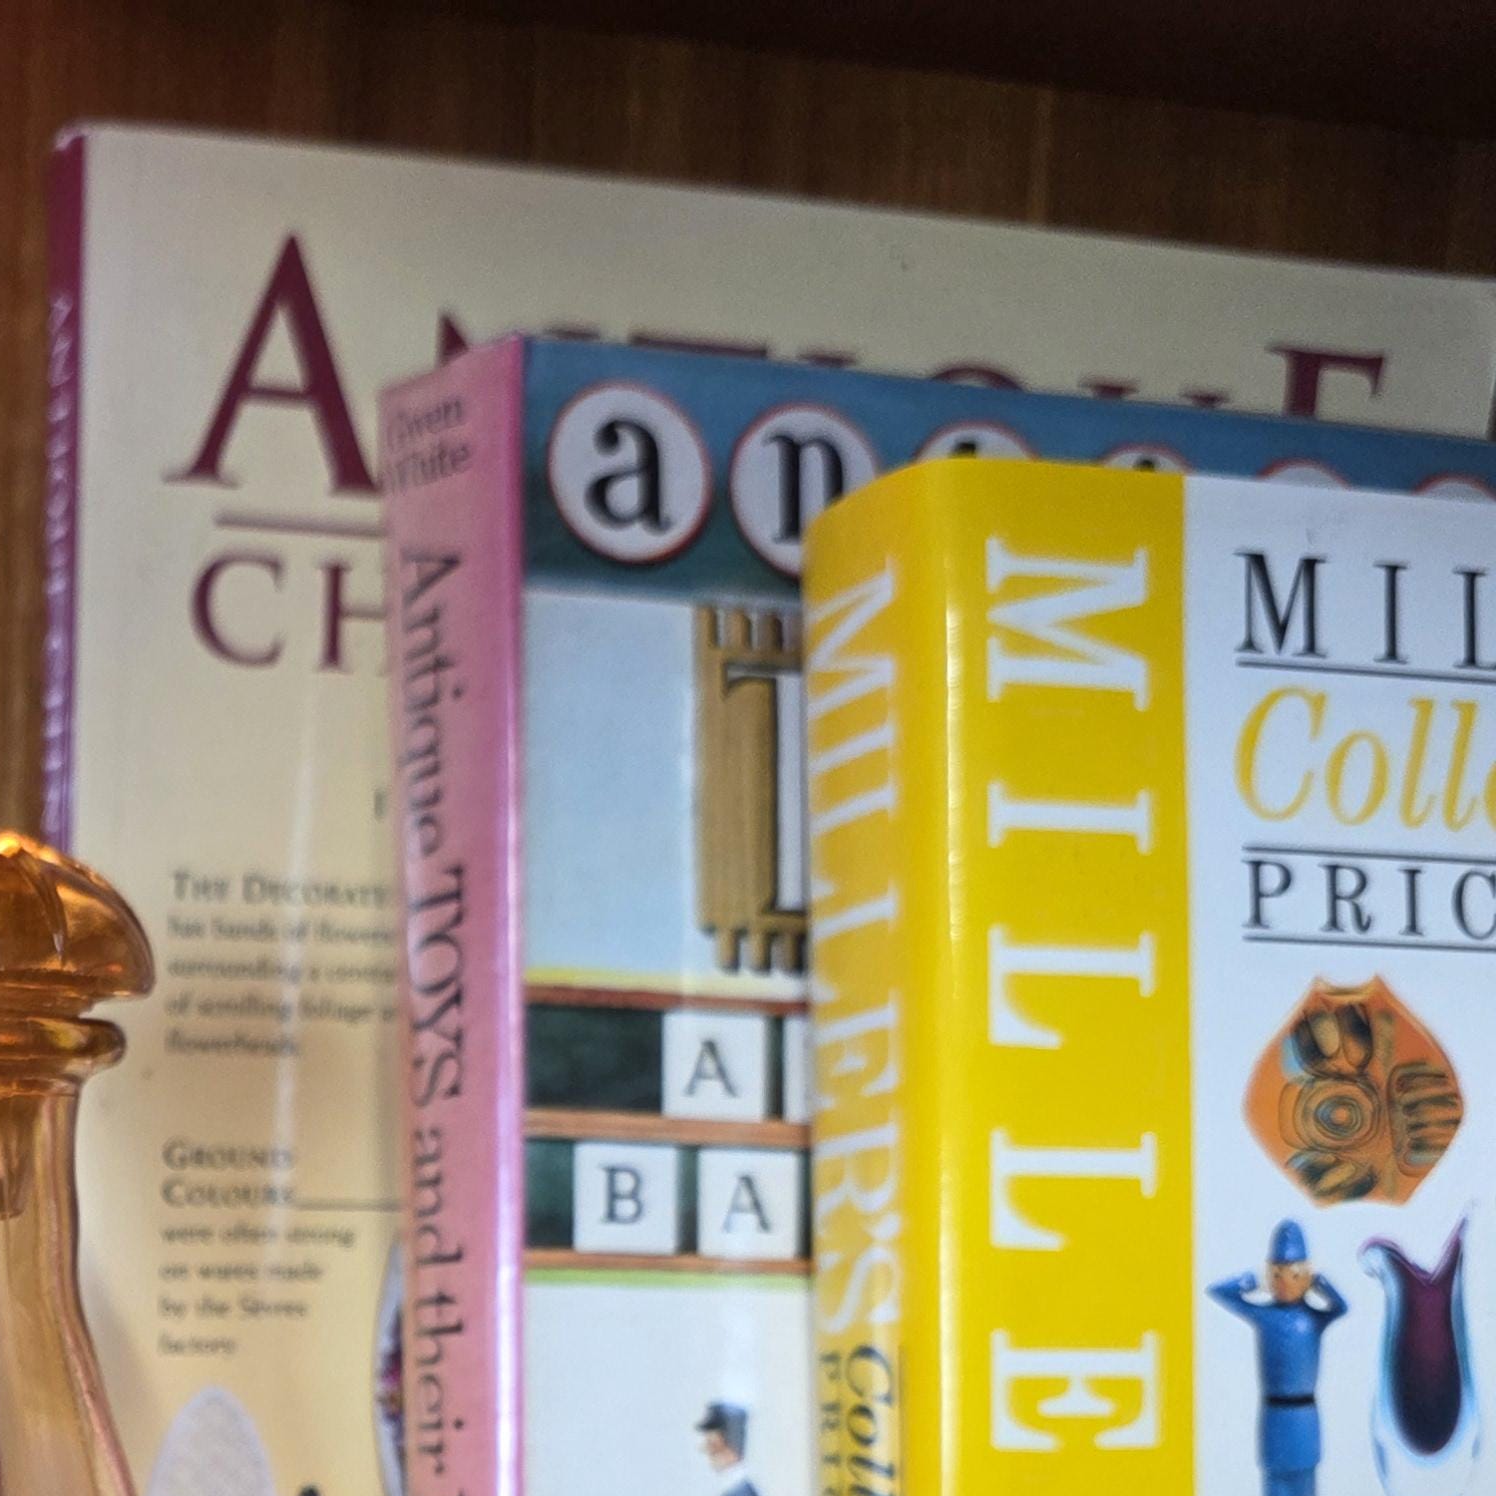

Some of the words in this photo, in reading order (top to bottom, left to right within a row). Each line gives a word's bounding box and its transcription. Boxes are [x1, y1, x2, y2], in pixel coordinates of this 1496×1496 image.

[401, 548, 461, 860] Antique
[1233, 683, 1496, 832] Coll
[410, 862, 464, 1107] TOYS
[807, 555, 902, 1335] MILLER'S
[413, 1125, 462, 1266] and
[413, 1290, 465, 1475] their
